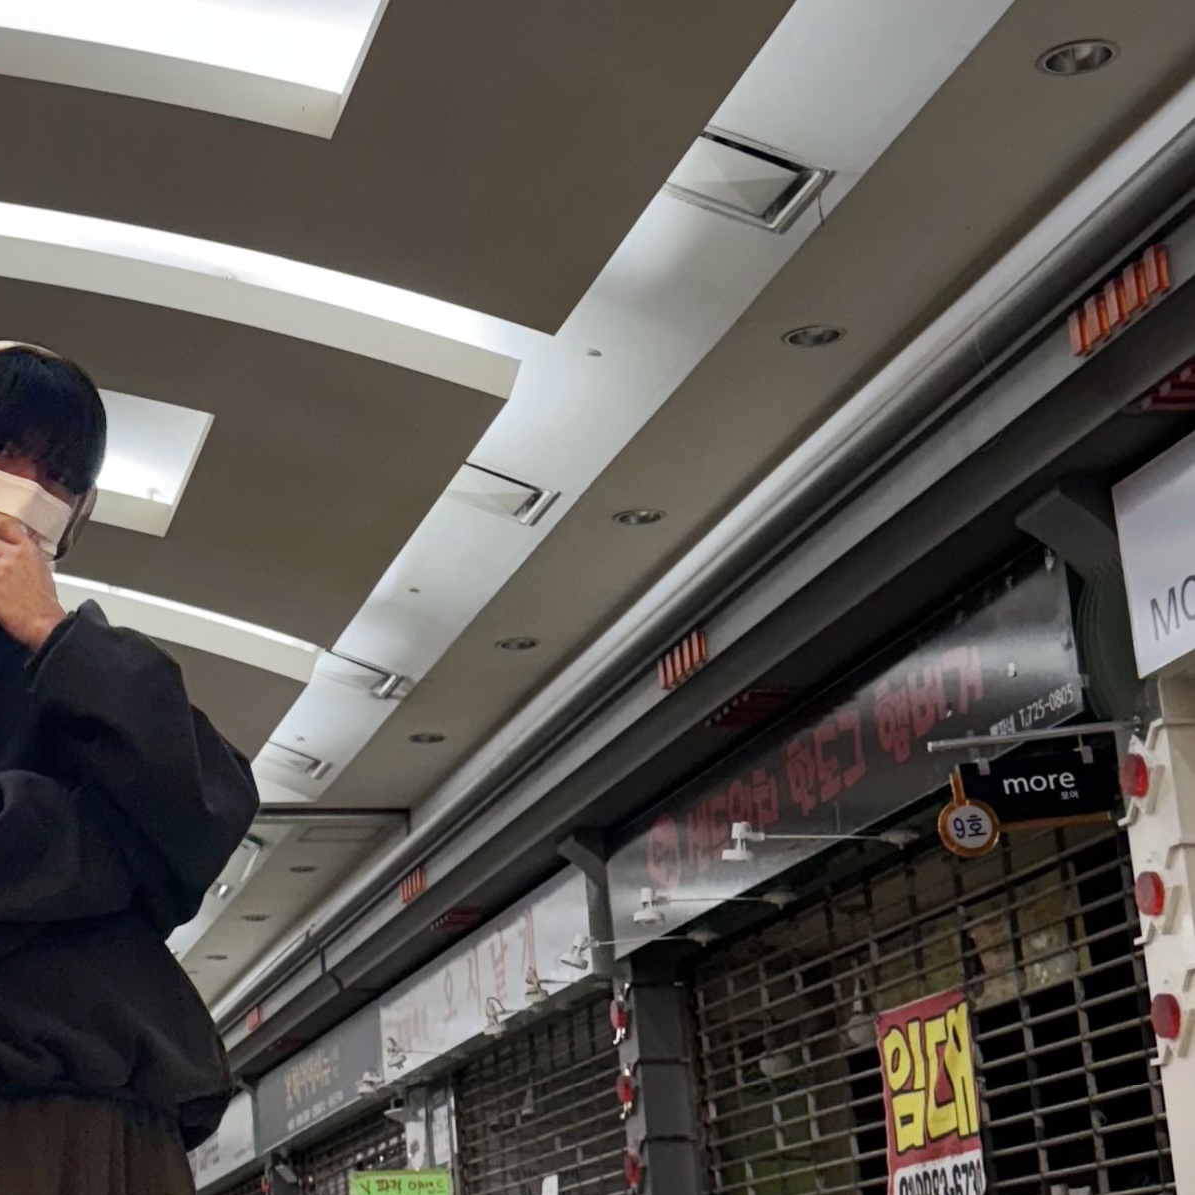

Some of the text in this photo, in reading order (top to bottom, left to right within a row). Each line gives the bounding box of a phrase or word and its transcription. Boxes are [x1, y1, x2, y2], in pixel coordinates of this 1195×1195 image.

[1003, 771, 1075, 795] more
[1060, 790, 1080, 800] 모어
[953, 814, 988, 839] 9호
[882, 1001, 979, 1156] 임대
